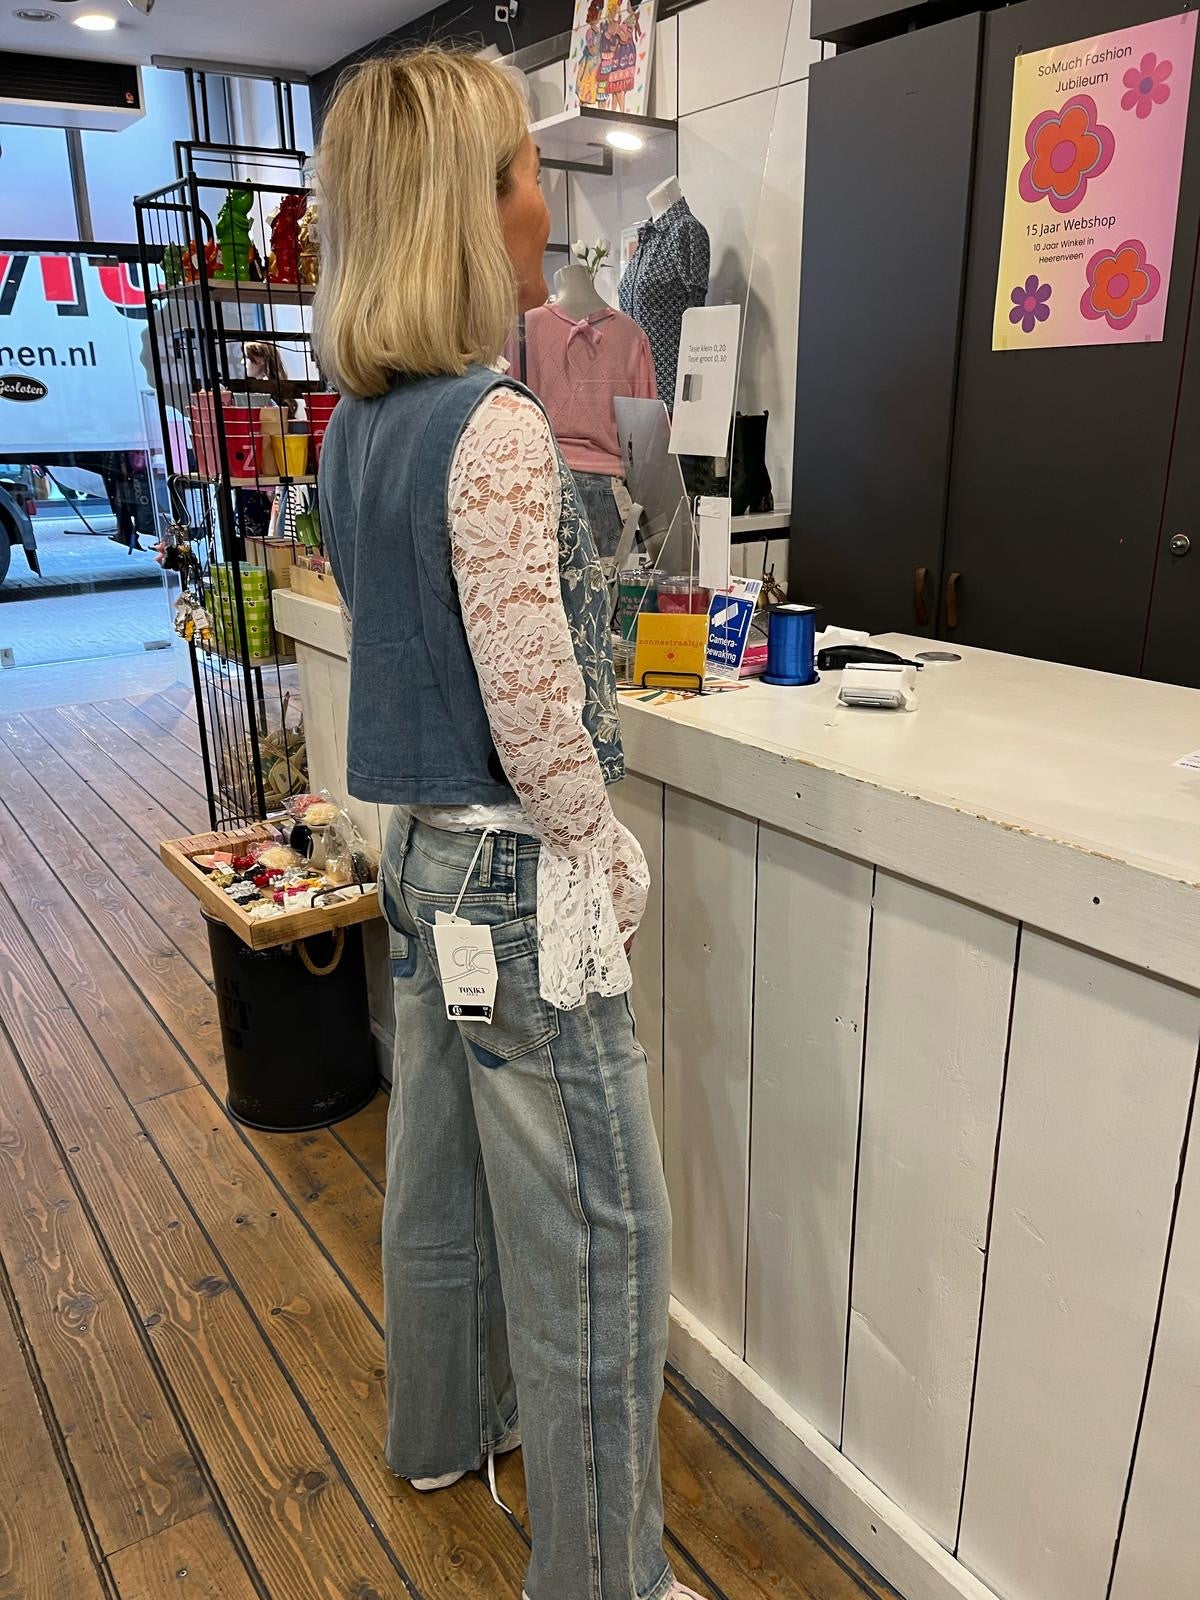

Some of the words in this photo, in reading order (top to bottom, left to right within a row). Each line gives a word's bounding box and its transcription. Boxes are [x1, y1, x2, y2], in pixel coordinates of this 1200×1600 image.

[1038, 57, 1082, 77] SoMuch
[1085, 46, 1132, 66] Fashion
[1055, 72, 1109, 93] Jubileum
[1026, 224, 1038, 236] 15
[1039, 223, 1061, 237] Jaar
[1063, 216, 1116, 231] Webshop
[1033, 243, 1041, 252] 10
[1042, 242, 1059, 251] Jaar
[1060, 239, 1085, 248] Winkel
[1086, 236, 1095, 245] in
[1039, 252, 1084, 264] Heerenveen
[709, 633, 738, 648] Camera-
